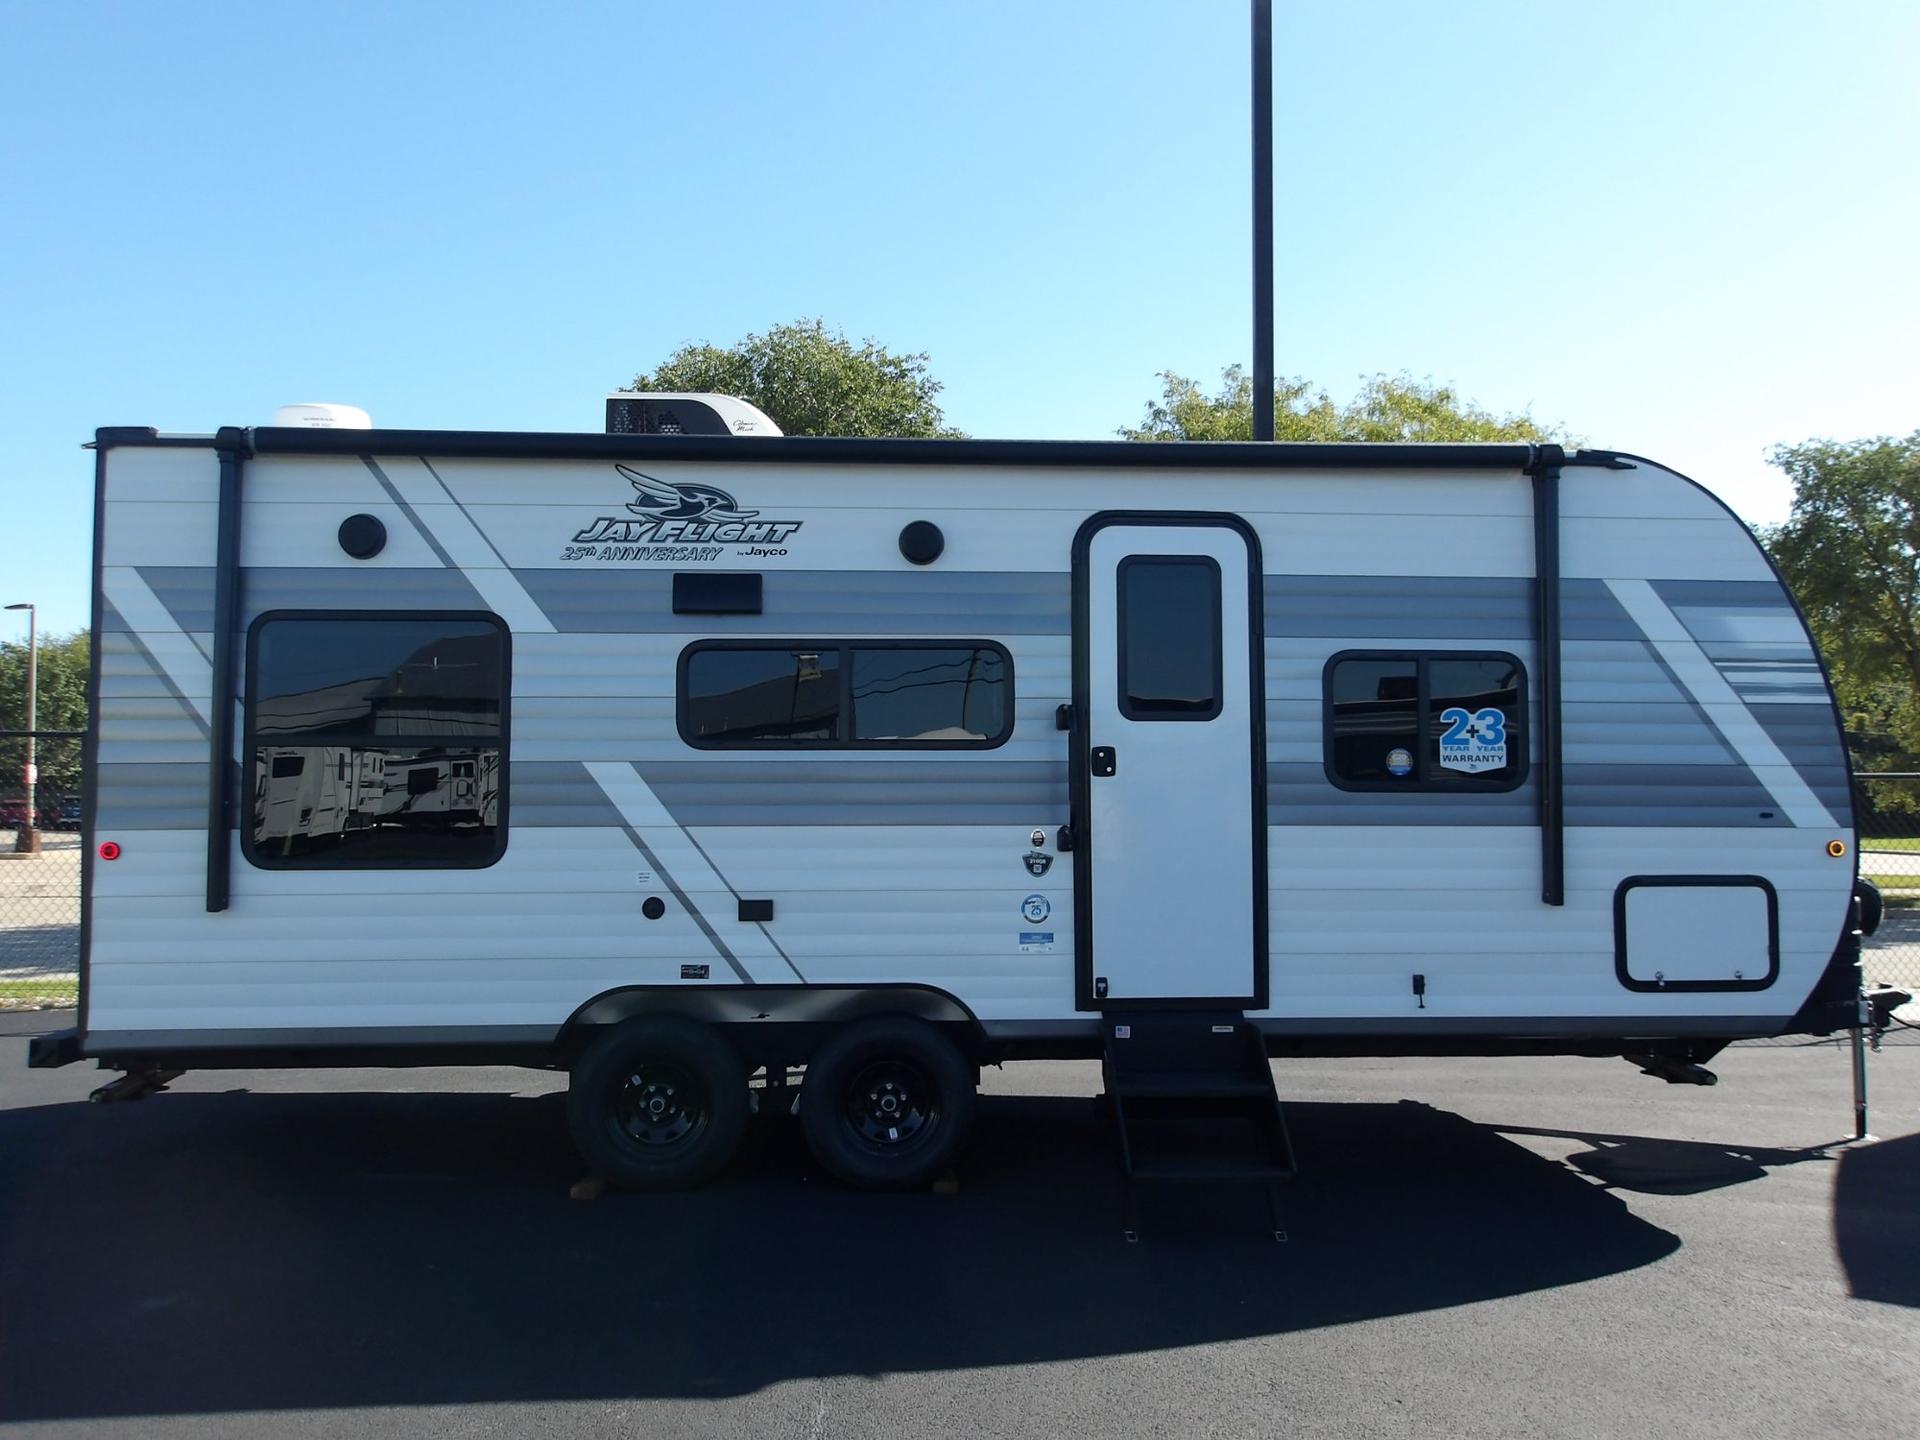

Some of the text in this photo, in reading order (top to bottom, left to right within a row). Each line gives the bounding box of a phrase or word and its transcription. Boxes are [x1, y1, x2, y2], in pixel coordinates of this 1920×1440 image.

[572, 517, 803, 544] JAY FLIGHT
[560, 546, 724, 562] 25th ANNIVERSARY
[744, 546, 788, 558] Jayco
[1442, 754, 1504, 763] WARRANTY
[1031, 904, 1042, 915] 25
